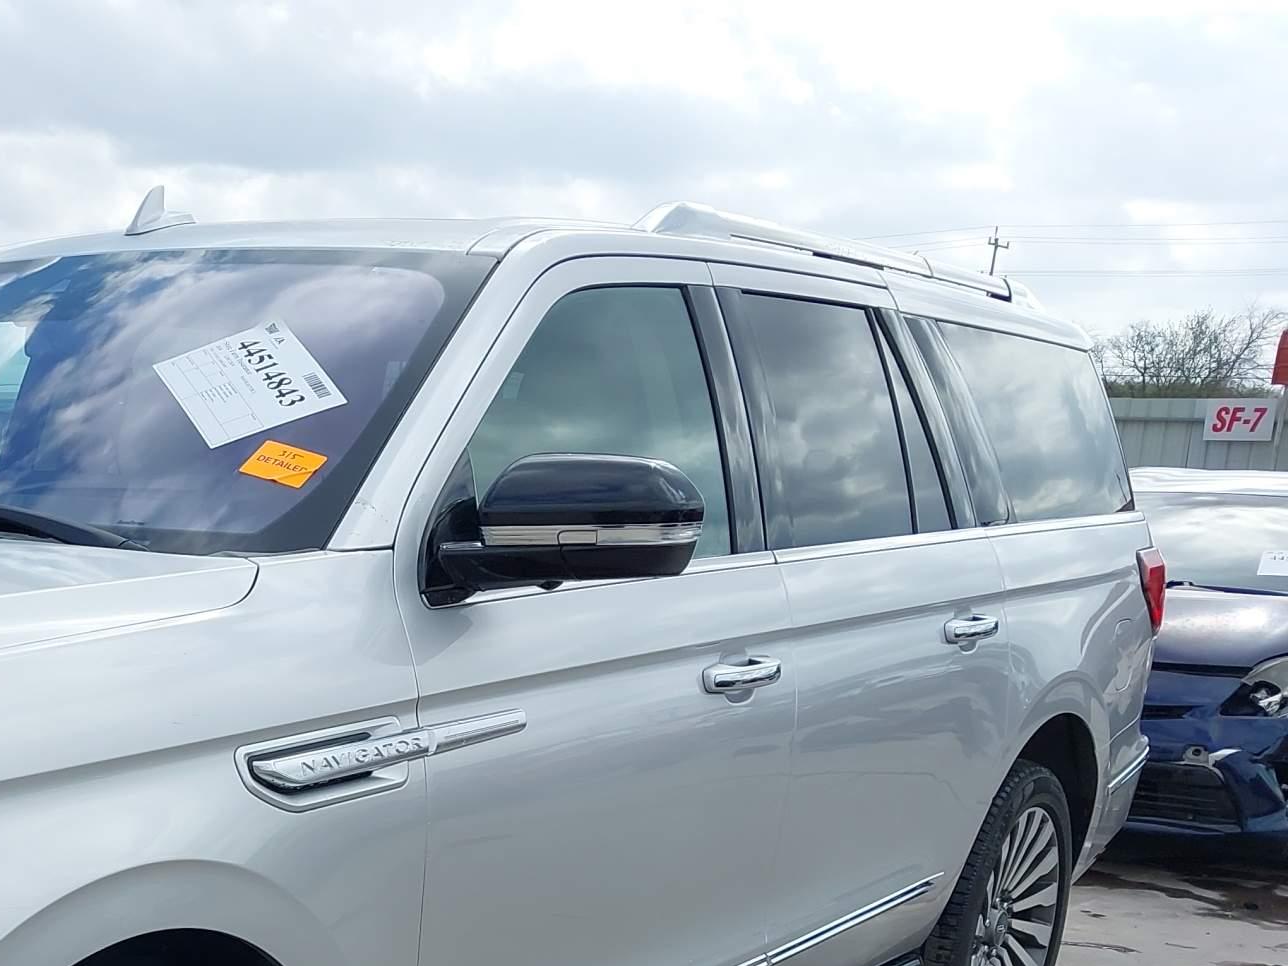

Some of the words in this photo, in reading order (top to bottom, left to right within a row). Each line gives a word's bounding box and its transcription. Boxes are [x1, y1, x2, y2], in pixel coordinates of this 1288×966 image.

[237, 340, 306, 407] 44514843
[1211, 406, 1269, 433] SF-7
[298, 736, 425, 777] NAVIGATOR
